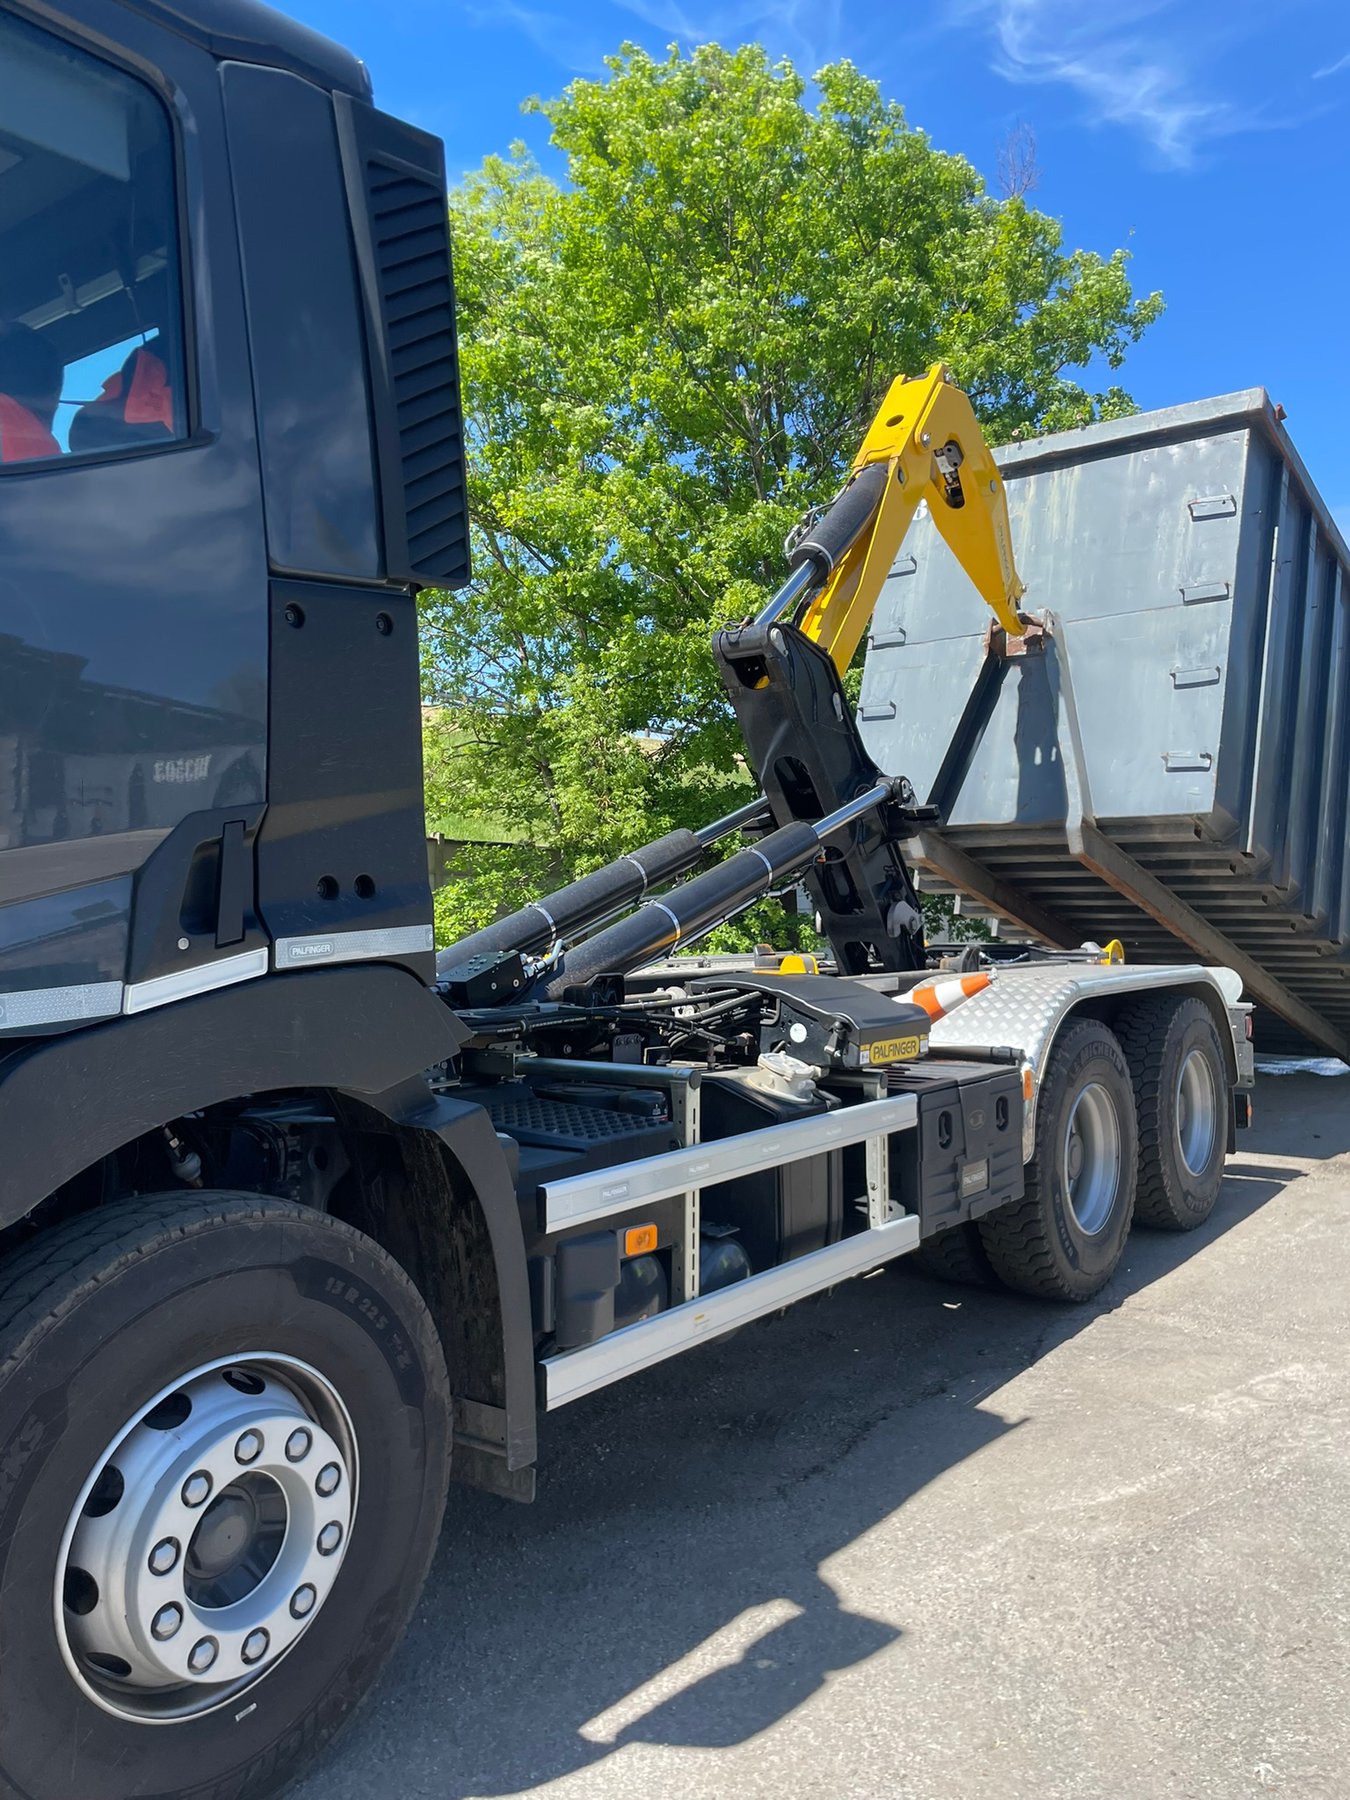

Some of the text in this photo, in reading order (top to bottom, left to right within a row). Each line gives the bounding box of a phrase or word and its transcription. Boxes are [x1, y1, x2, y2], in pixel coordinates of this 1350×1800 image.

[291, 944, 332, 956] PALFINGER
[873, 1039, 917, 1060] PALFINGER
[325, 1276, 346, 1295] 13
[344, 1286, 360, 1304] R
